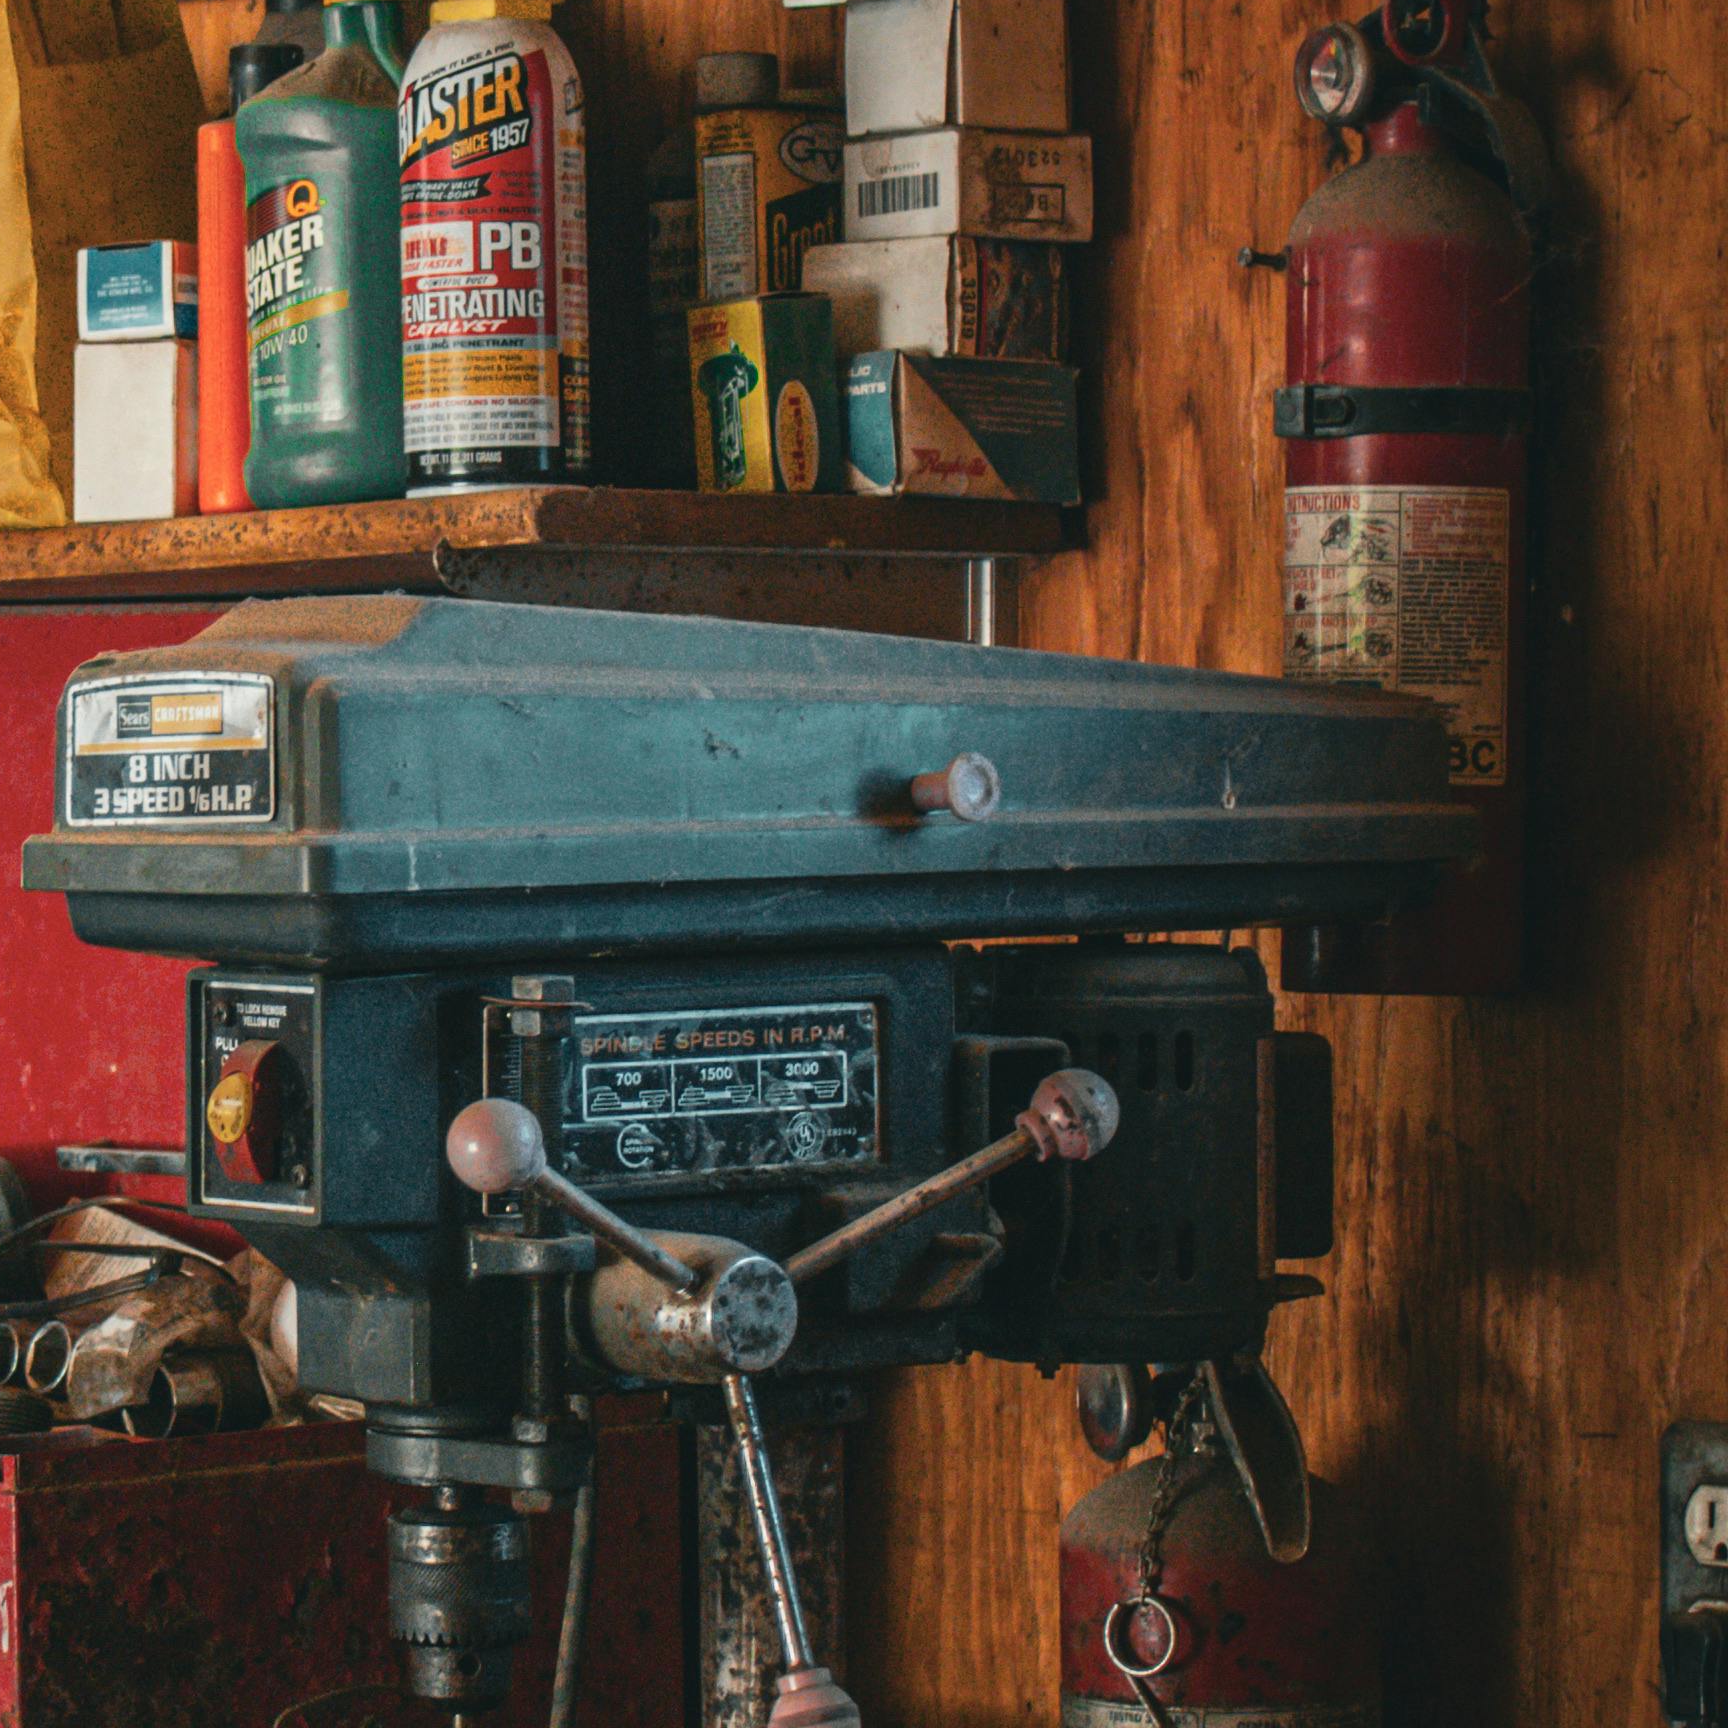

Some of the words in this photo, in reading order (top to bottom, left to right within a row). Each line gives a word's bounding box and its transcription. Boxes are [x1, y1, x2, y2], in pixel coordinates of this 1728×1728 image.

[421, 66, 446, 82] WORK
[448, 60, 459, 70] IT
[460, 53, 483, 66] LIKE
[484, 49, 493, 58] A
[494, 41, 515, 55] PRO
[452, 131, 490, 161] SINCE
[489, 117, 531, 154] 1957
[450, 177, 481, 191] VALVE
[285, 179, 321, 219] Q
[479, 221, 542, 271] PB
[423, 257, 464, 272] FASTER
[407, 319, 508, 338] CATALYST
[452, 337, 526, 349] PENETRANT
[120, 706, 150, 727] Sears
[154, 704, 220, 723] CRAFTSMAN
[128, 754, 148, 783] 8
[152, 752, 210, 781] INCH
[93, 787, 111, 815] 3
[112, 786, 185, 815] SPEED
[243, 1015, 268, 1029] YELLOW
[268, 1017, 281, 1029] KEY
[244, 1002, 261, 1015] LOCK
[261, 1003, 287, 1017] REMOVE
[579, 1034, 667, 1057] SPINDLE
[675, 1028, 756, 1050] SPEEDS
[763, 1027, 784, 1046] IN
[790, 1023, 850, 1044] R.P.M.
[615, 1071, 642, 1087] 700
[699, 1066, 733, 1082] 1500
[784, 1061, 819, 1077] 3000
